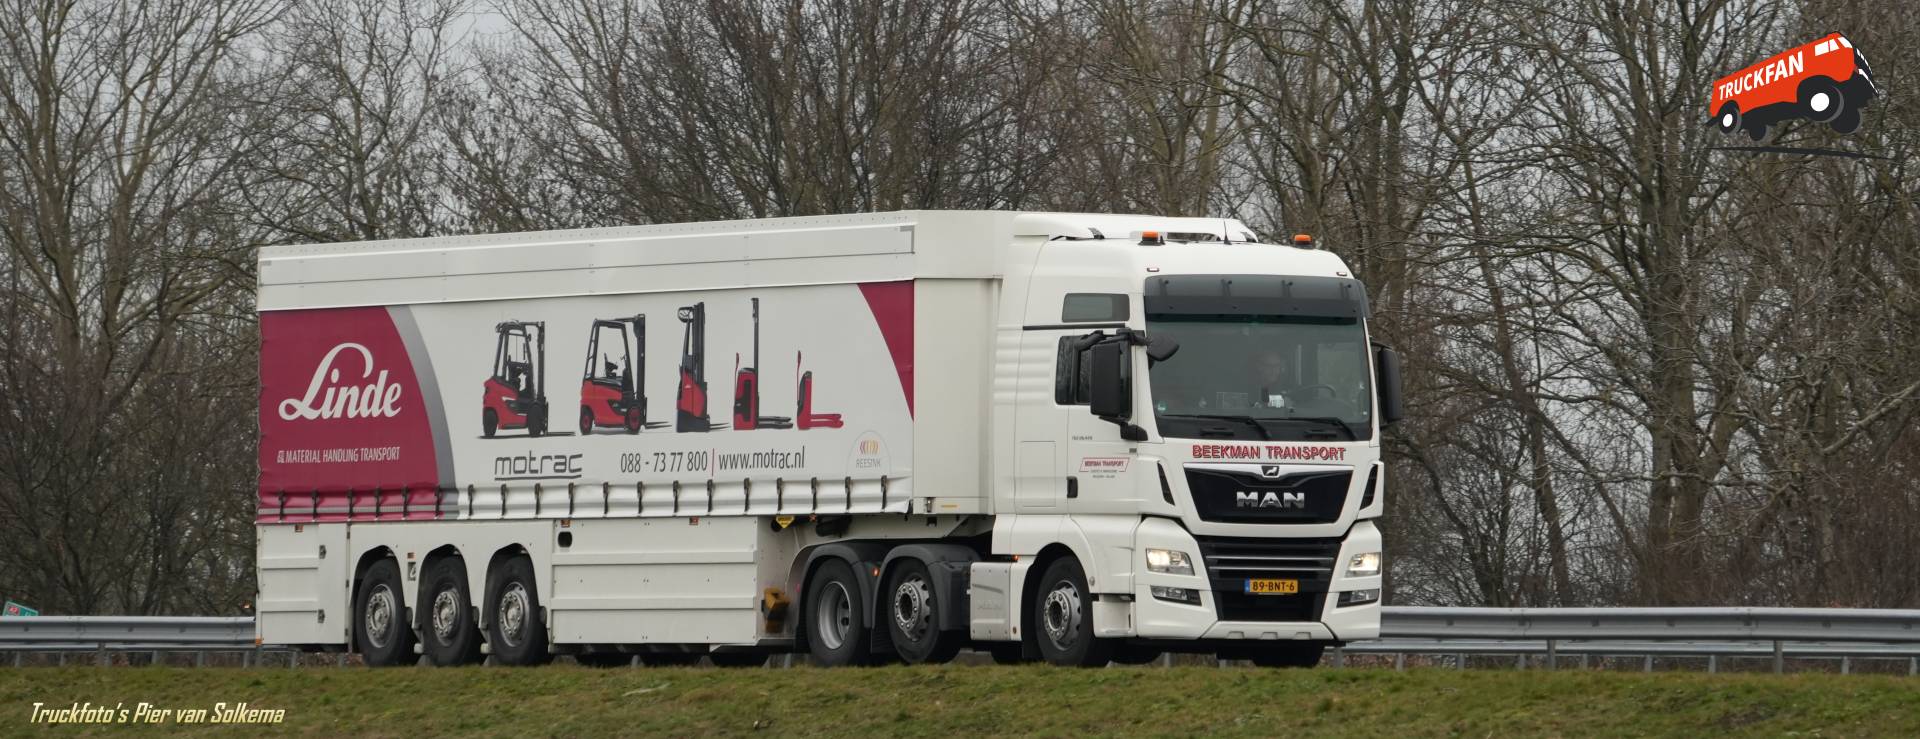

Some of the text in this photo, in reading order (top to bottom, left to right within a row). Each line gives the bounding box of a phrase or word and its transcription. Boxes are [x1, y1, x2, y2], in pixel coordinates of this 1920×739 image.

[278, 342, 402, 421] Linde
[286, 449, 321, 463] MATERIAL
[323, 448, 359, 462] HANDLING
[360, 446, 400, 461] TRANSPORT
[620, 453, 641, 473] 088
[653, 452, 666, 472] 73
[670, 452, 683, 471] 77
[687, 451, 708, 471] 800
[719, 446, 805, 470] www.motrac.nl
[1192, 444, 1346, 461] BEEKMAN TRANSPORT
[495, 450, 583, 475] motrac
[1236, 491, 1305, 508] MAN
[1252, 581, 1295, 592] 89-BNT-6
